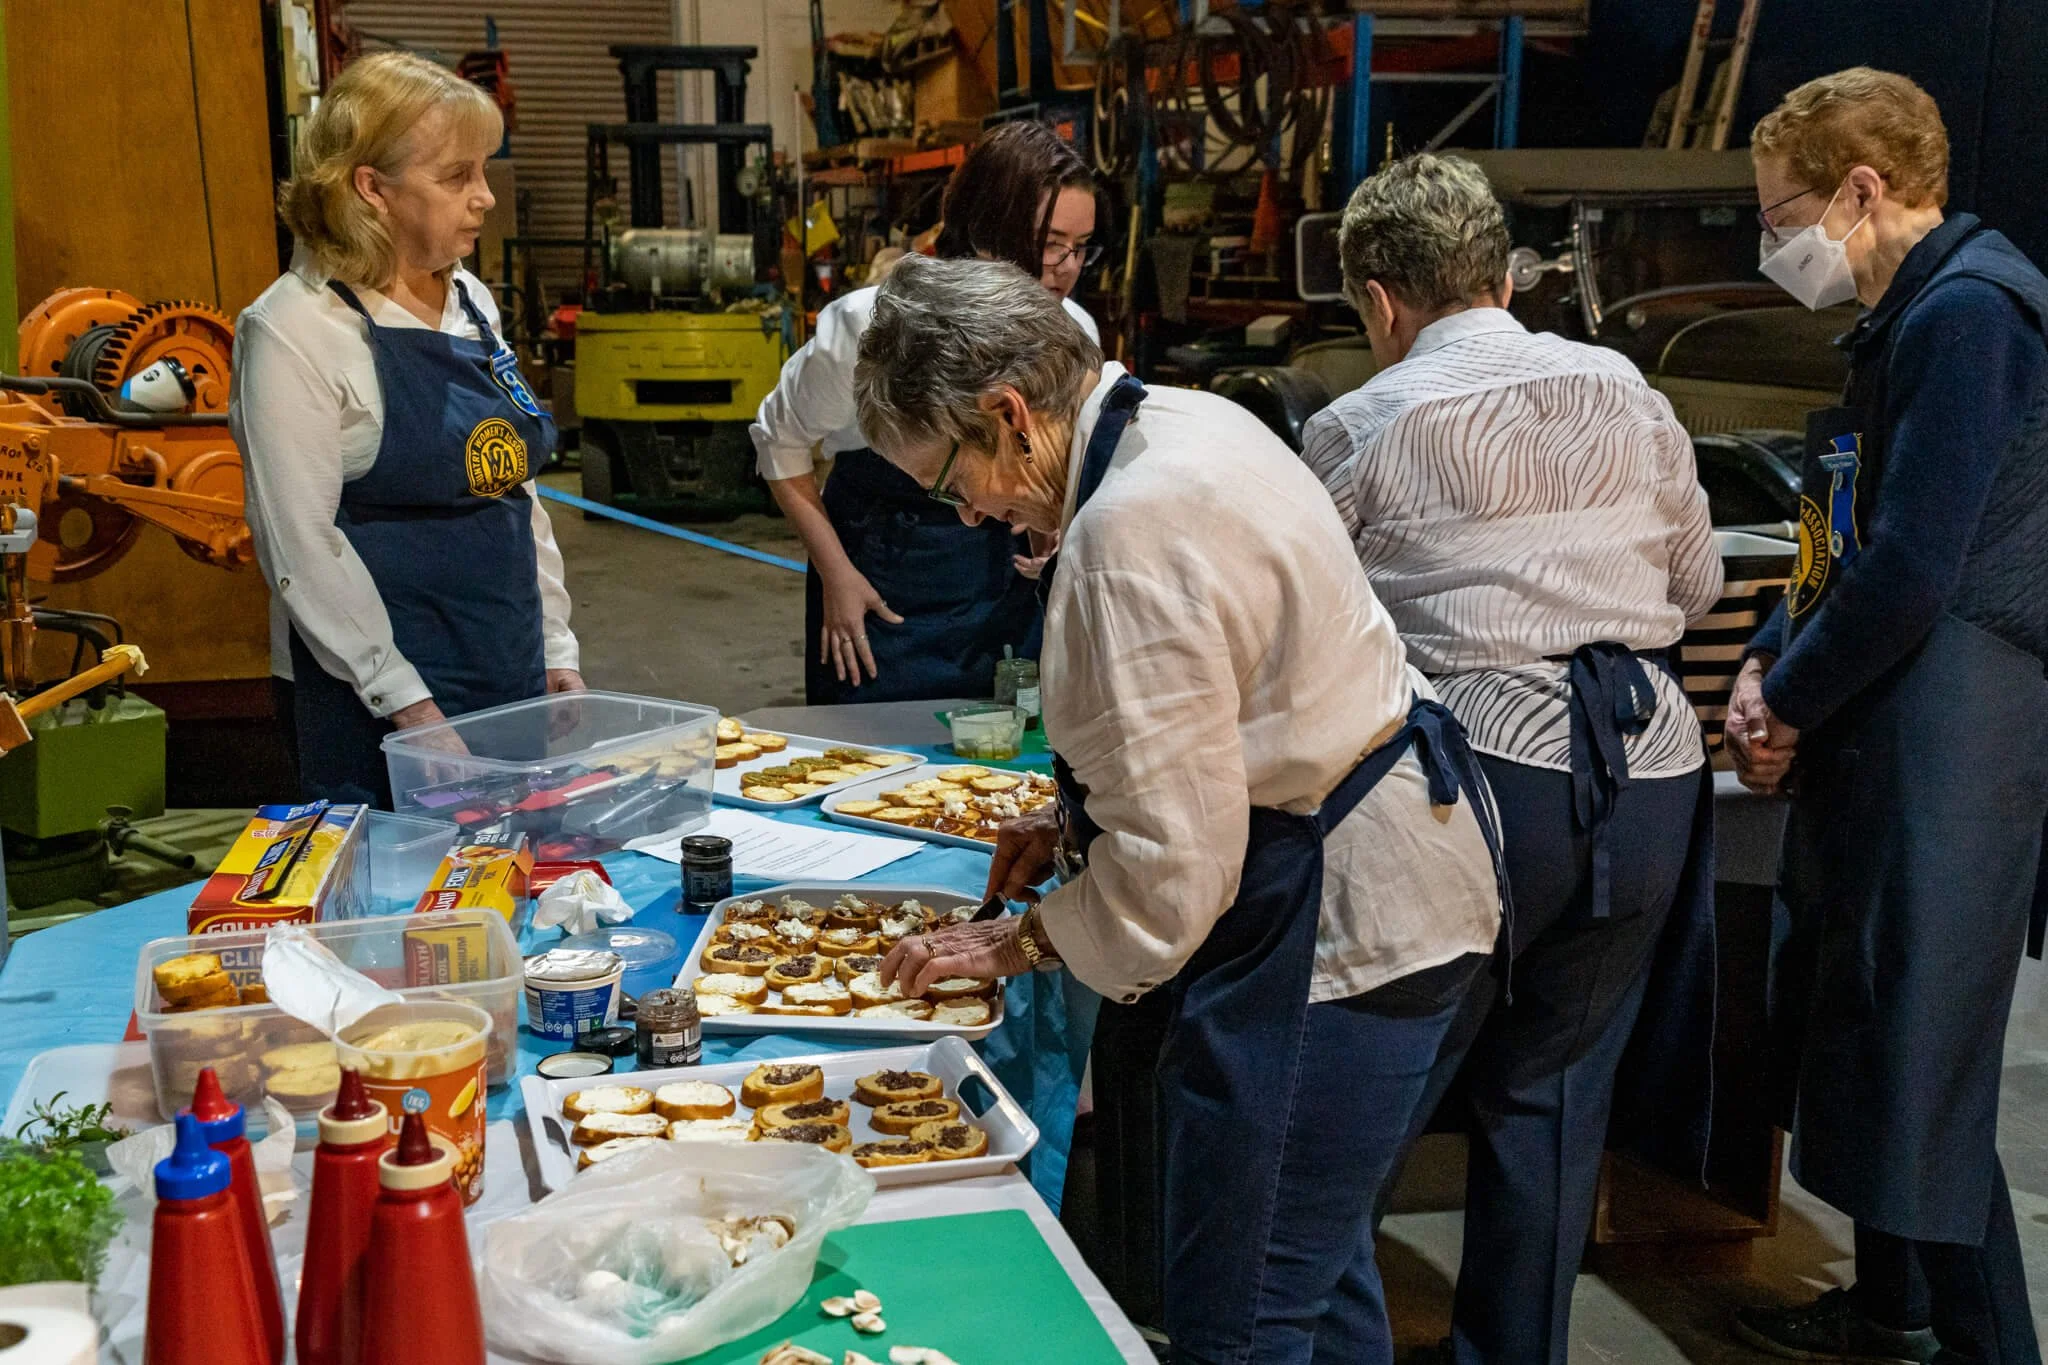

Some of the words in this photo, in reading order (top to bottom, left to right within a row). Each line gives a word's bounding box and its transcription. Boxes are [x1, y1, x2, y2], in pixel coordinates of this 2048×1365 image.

[503, 431, 525, 481] ASSOCIATIO
[1803, 506, 1827, 590] ASSOCIATION
[444, 868, 469, 889] FOIL
[431, 891, 457, 913] LIATH
